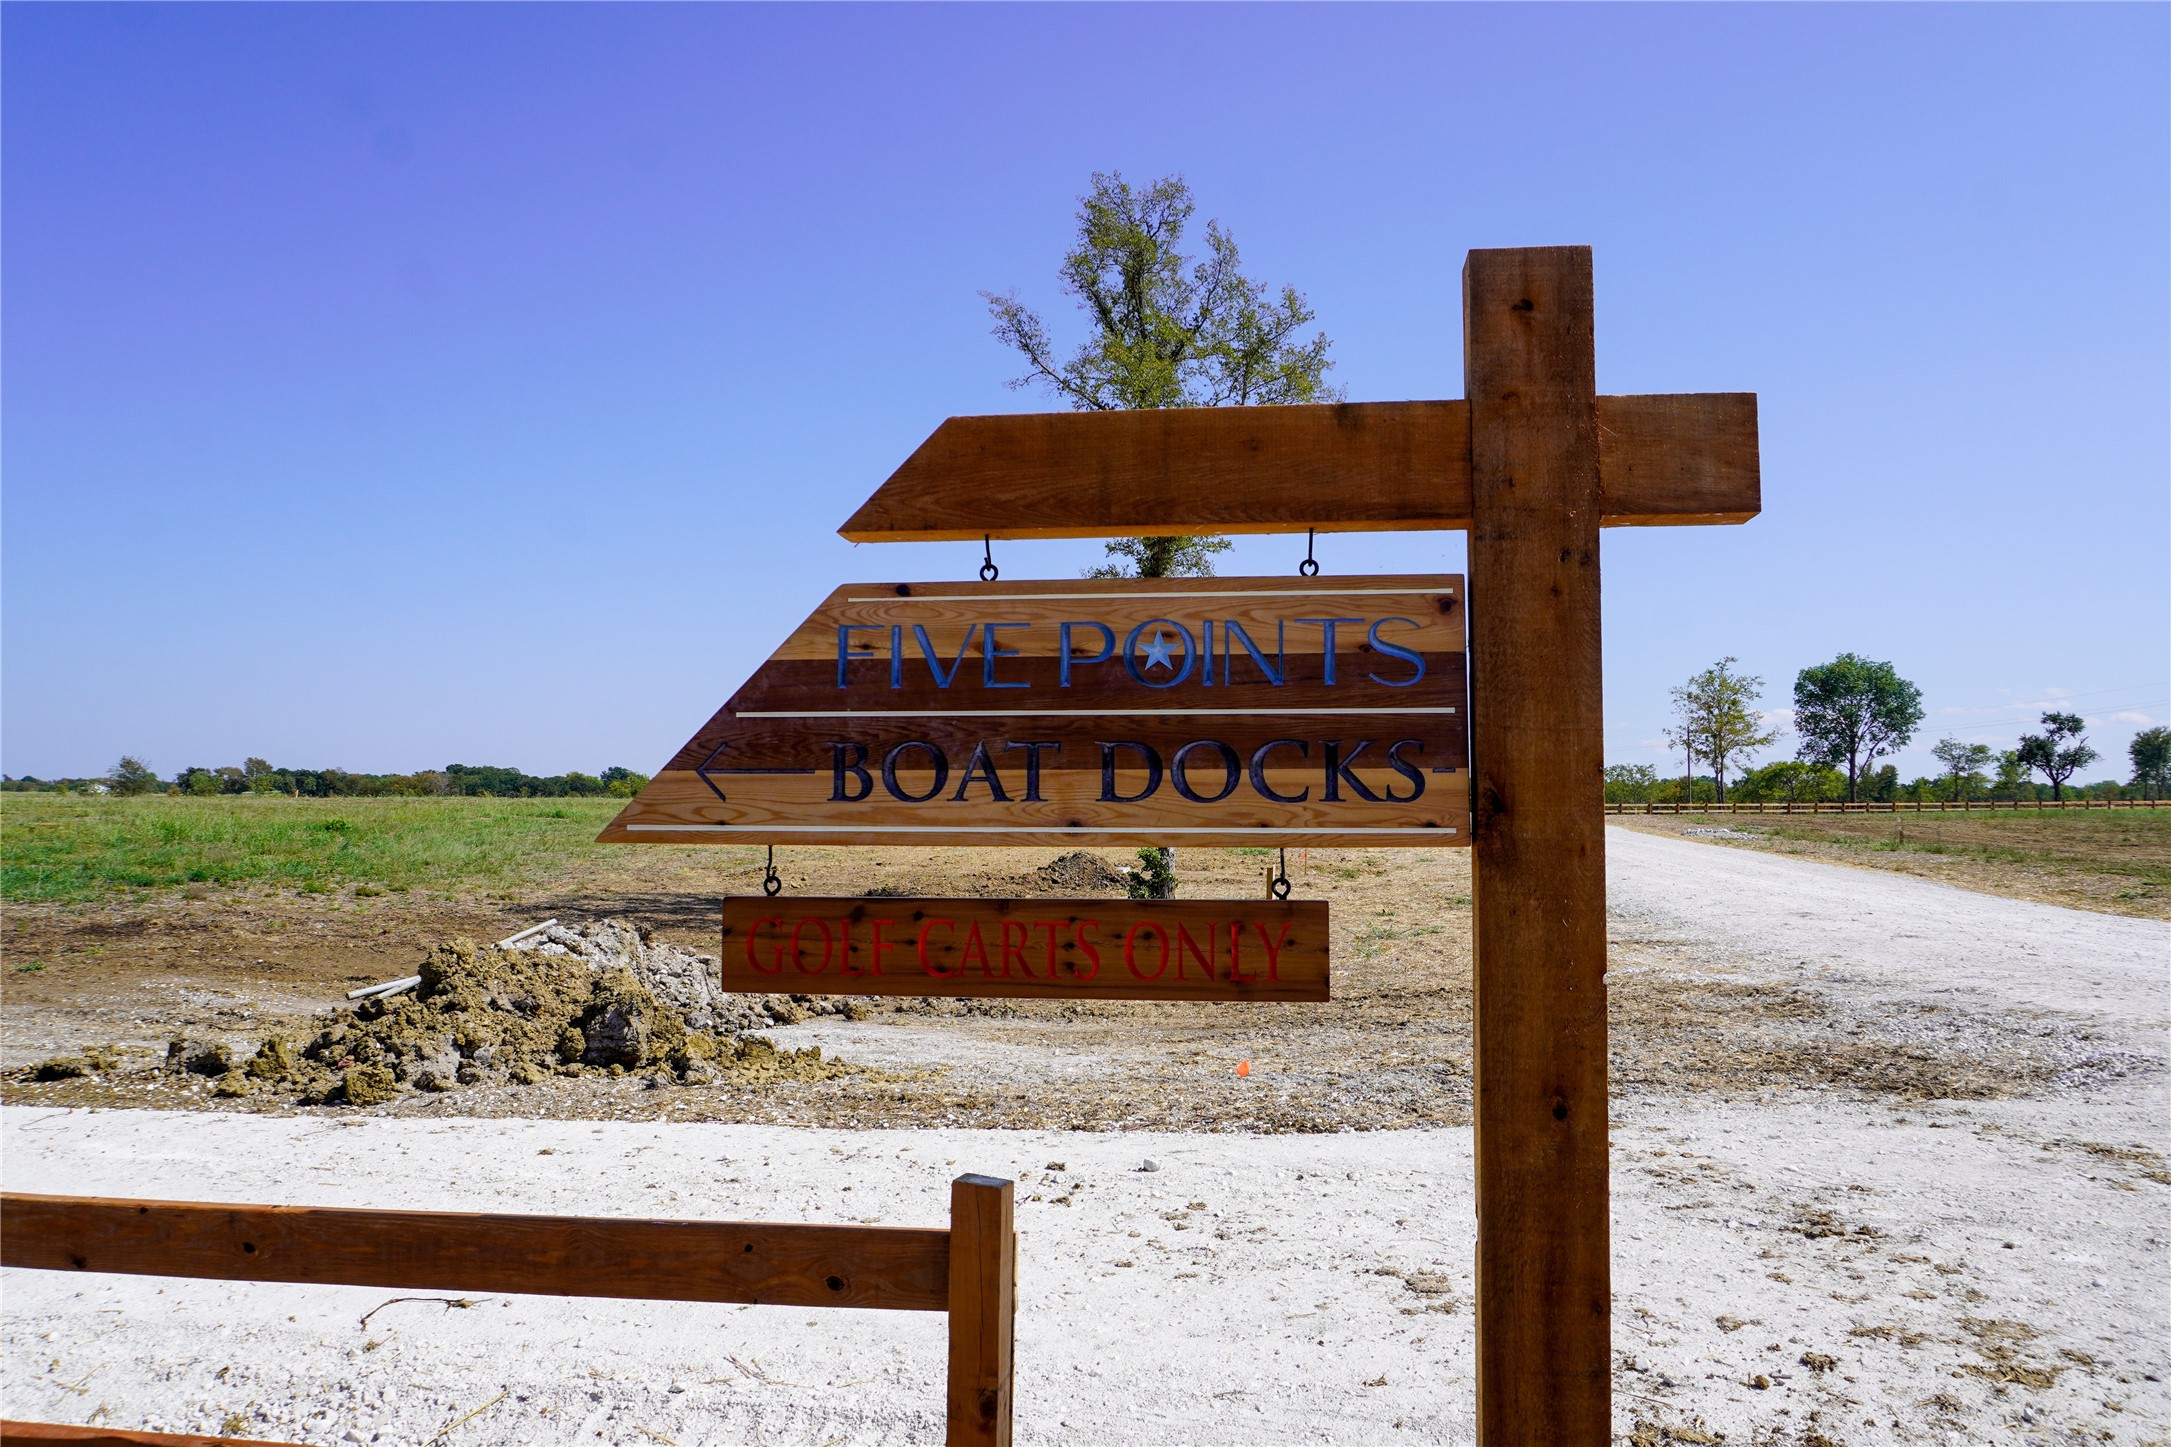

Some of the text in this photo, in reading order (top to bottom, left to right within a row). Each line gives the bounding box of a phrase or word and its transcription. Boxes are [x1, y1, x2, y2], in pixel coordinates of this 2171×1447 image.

[837, 616, 1427, 690] FIVE POINTS
[826, 738, 1427, 803] BOAT DOCKS
[745, 917, 1293, 983] GOLF CARTS ONLY
